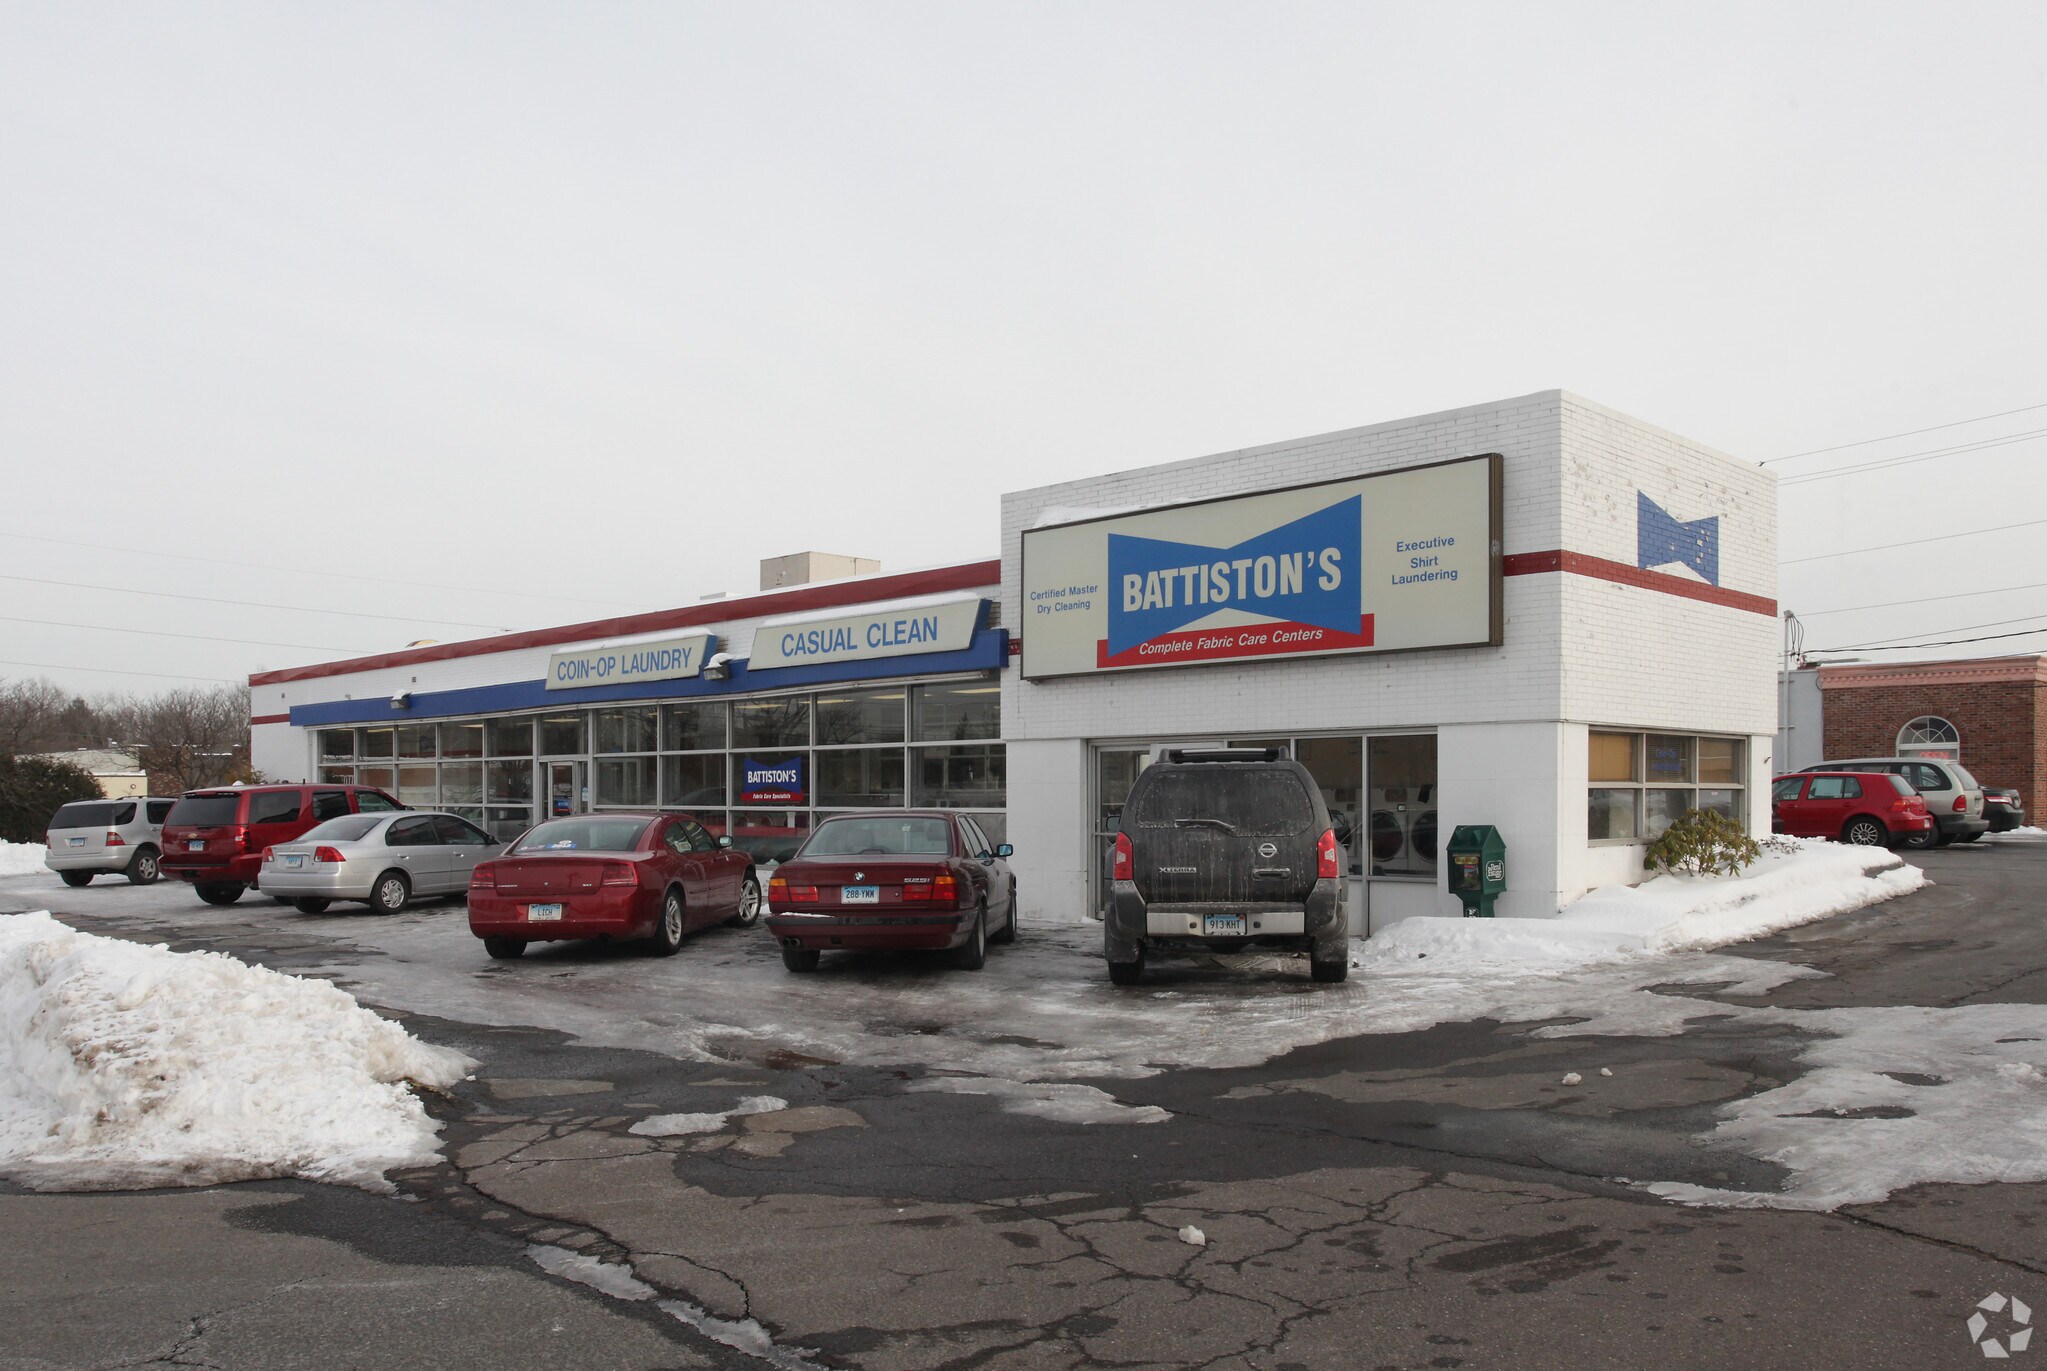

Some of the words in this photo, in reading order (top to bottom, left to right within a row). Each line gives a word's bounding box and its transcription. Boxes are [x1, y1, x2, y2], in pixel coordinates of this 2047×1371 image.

[1396, 536, 1455, 552] Executive
[1410, 555, 1439, 569] Shirt
[1123, 547, 1342, 613] BATTISTON'S
[1391, 569, 1458, 585] Laundering
[1030, 588, 1066, 601] Certified
[1068, 584, 1098, 596] Master
[1037, 604, 1052, 615] Dry
[1054, 600, 1091, 612] Cleaning
[781, 629, 858, 657] CASUAL
[866, 616, 938, 648] CLEAN
[1139, 639, 1193, 655] Complete
[1197, 635, 1233, 650] Fabric
[1238, 631, 1267, 646] Care
[1272, 628, 1323, 644] Centers
[557, 656, 616, 682] COIN-OP
[621, 647, 692, 675] LAUNDRY
[747, 769, 797, 783] BATTISTON'S
